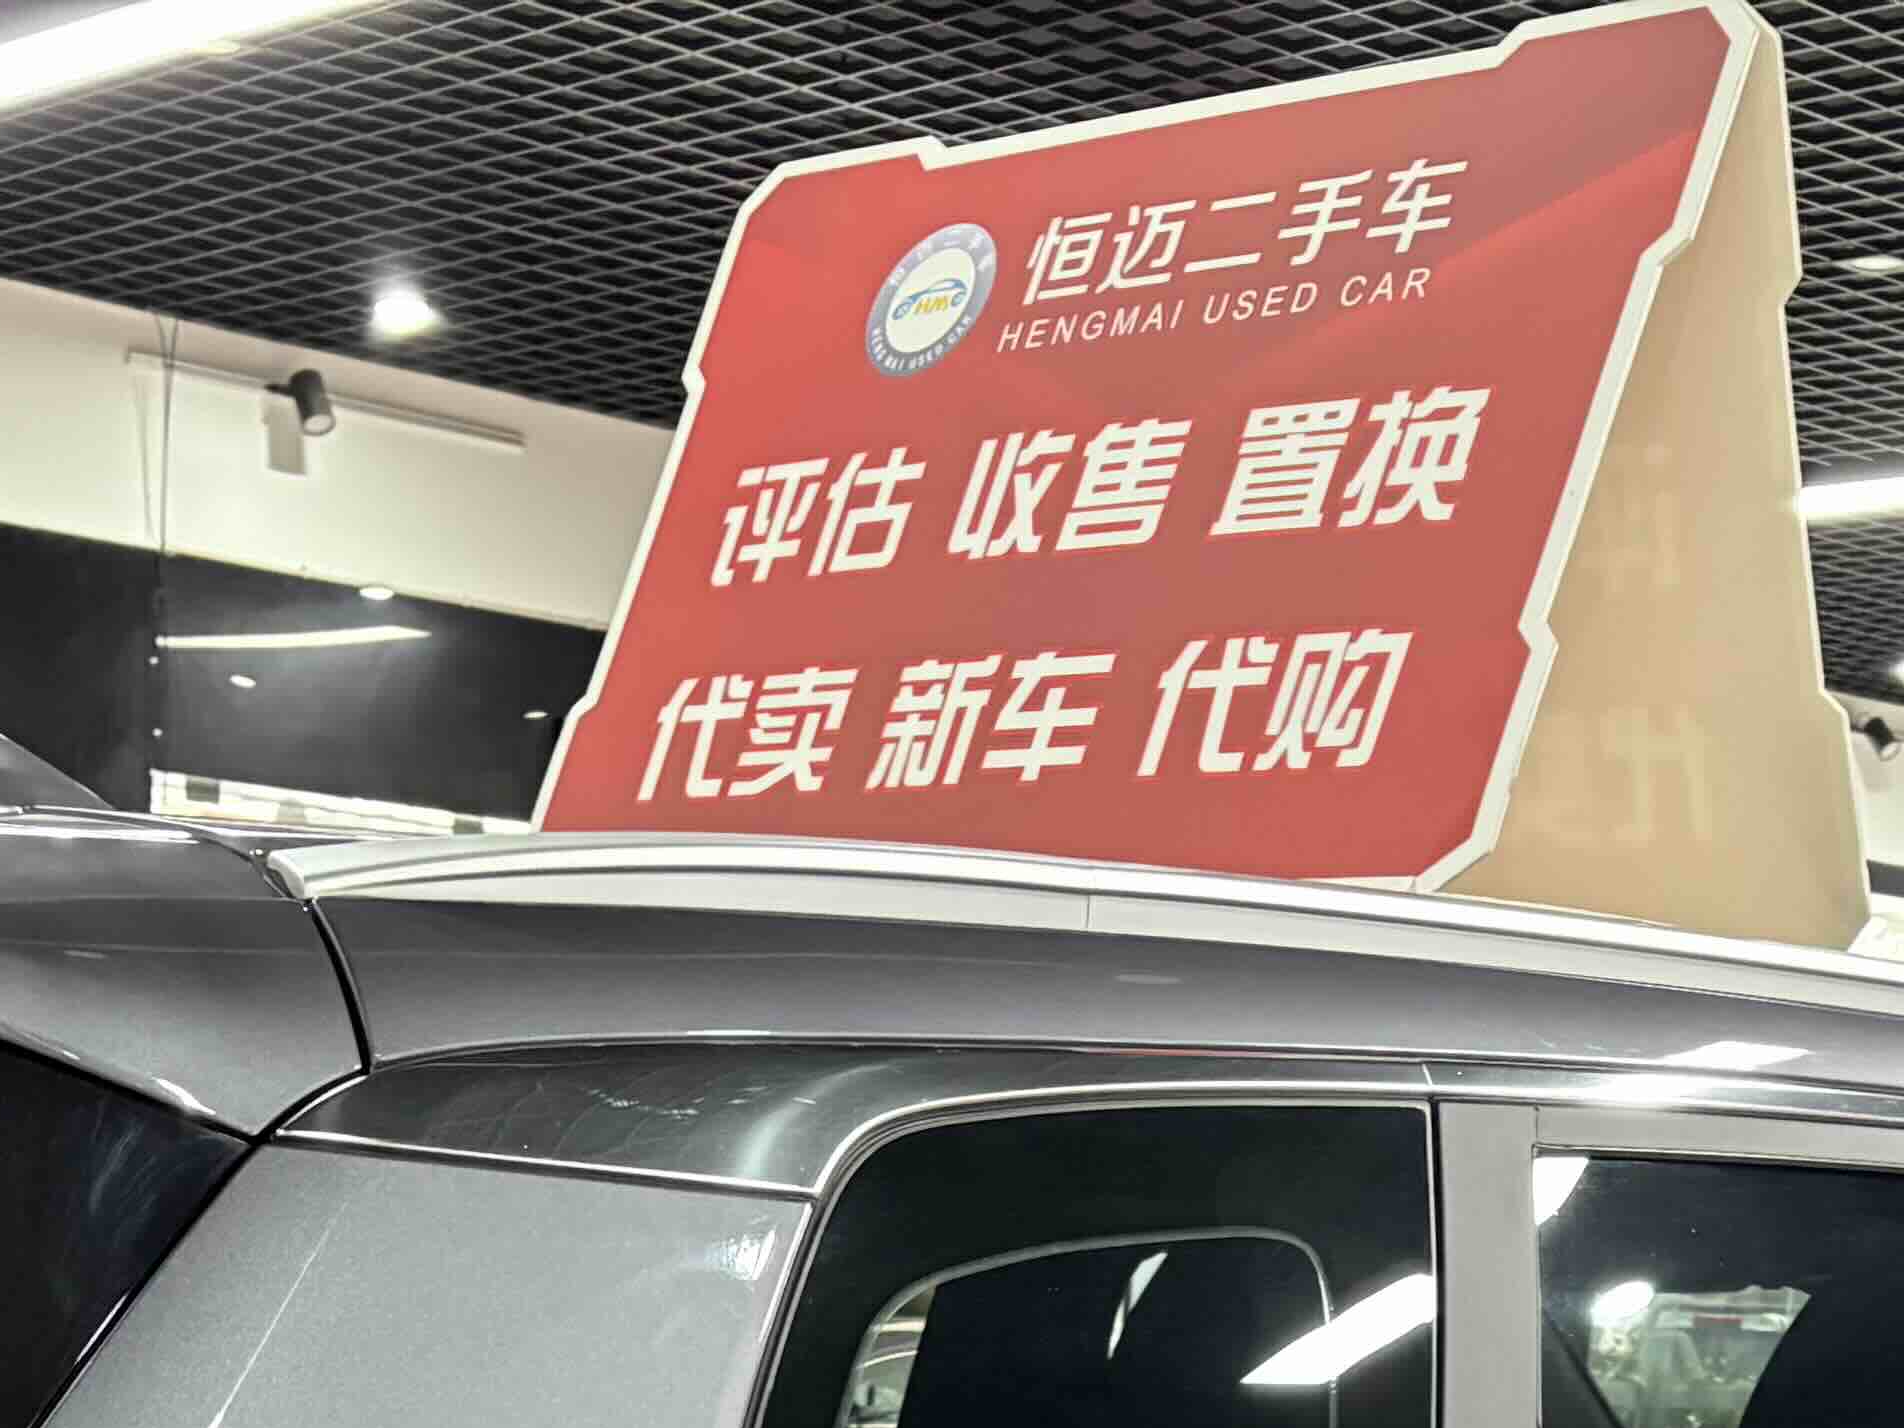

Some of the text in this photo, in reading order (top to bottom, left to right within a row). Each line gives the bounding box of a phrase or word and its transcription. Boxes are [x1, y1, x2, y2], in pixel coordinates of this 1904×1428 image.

[997, 267, 1432, 353] HENGMAI USED CAR
[1022, 158, 1469, 305] 恒迈二手车
[711, 385, 1492, 588] 评估 收售 置换
[637, 626, 1414, 803] 代卖 新车 代购
